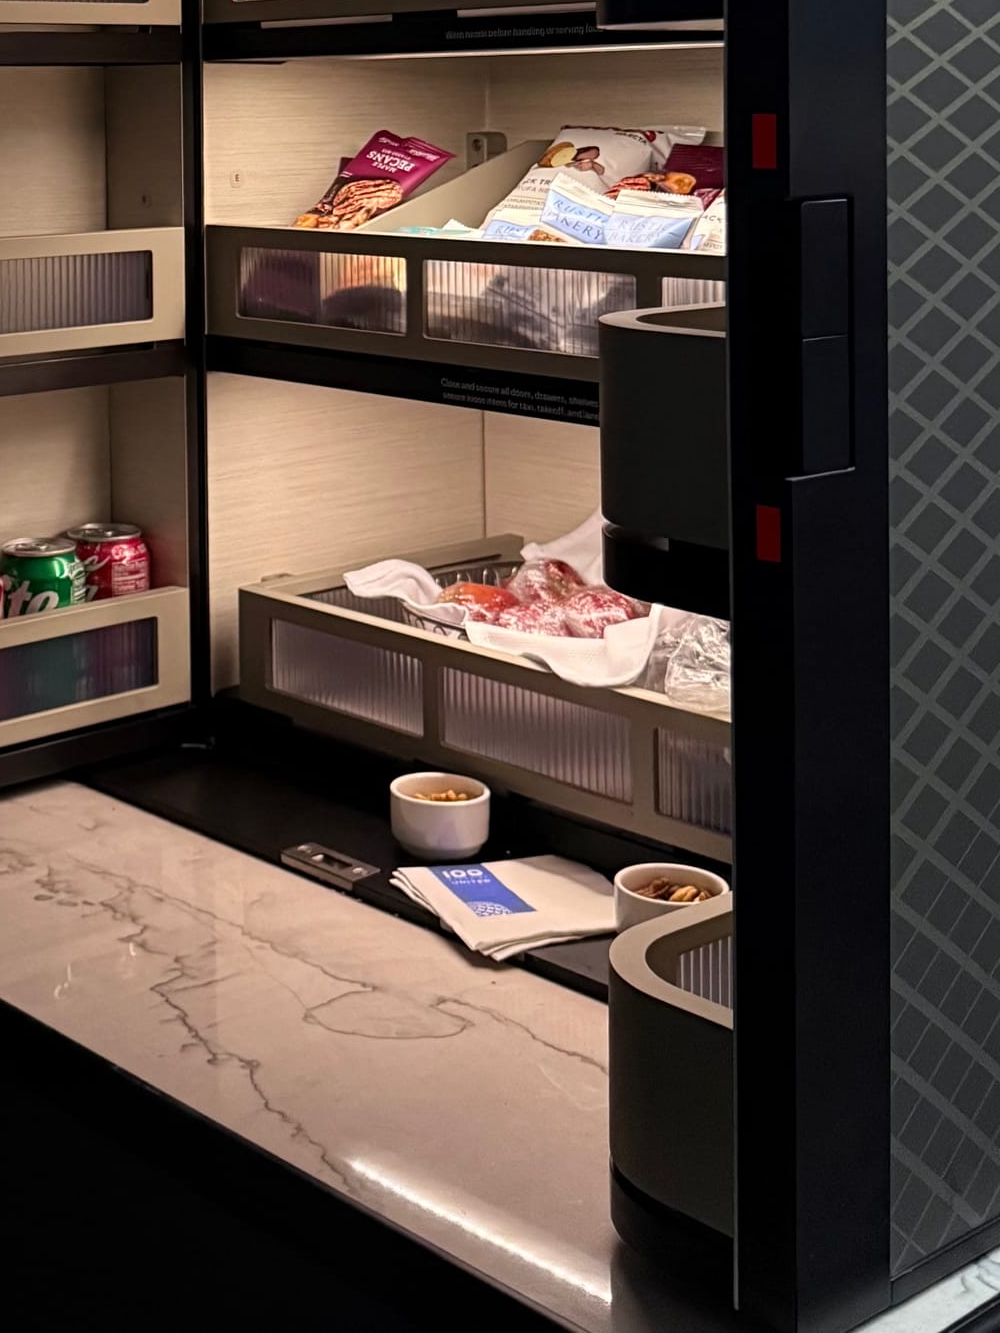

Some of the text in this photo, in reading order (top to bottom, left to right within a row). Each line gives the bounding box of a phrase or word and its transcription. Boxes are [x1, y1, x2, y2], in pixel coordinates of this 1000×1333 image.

[366, 150, 416, 173] PECANS
[371, 161, 398, 174] MAPLE
[545, 210, 604, 241] AKERY
[440, 377, 460, 389] Close
[460, 381, 475, 391] and
[476, 384, 500, 395] secure
[500, 386, 510, 396] all
[507, 399, 519, 409] for
